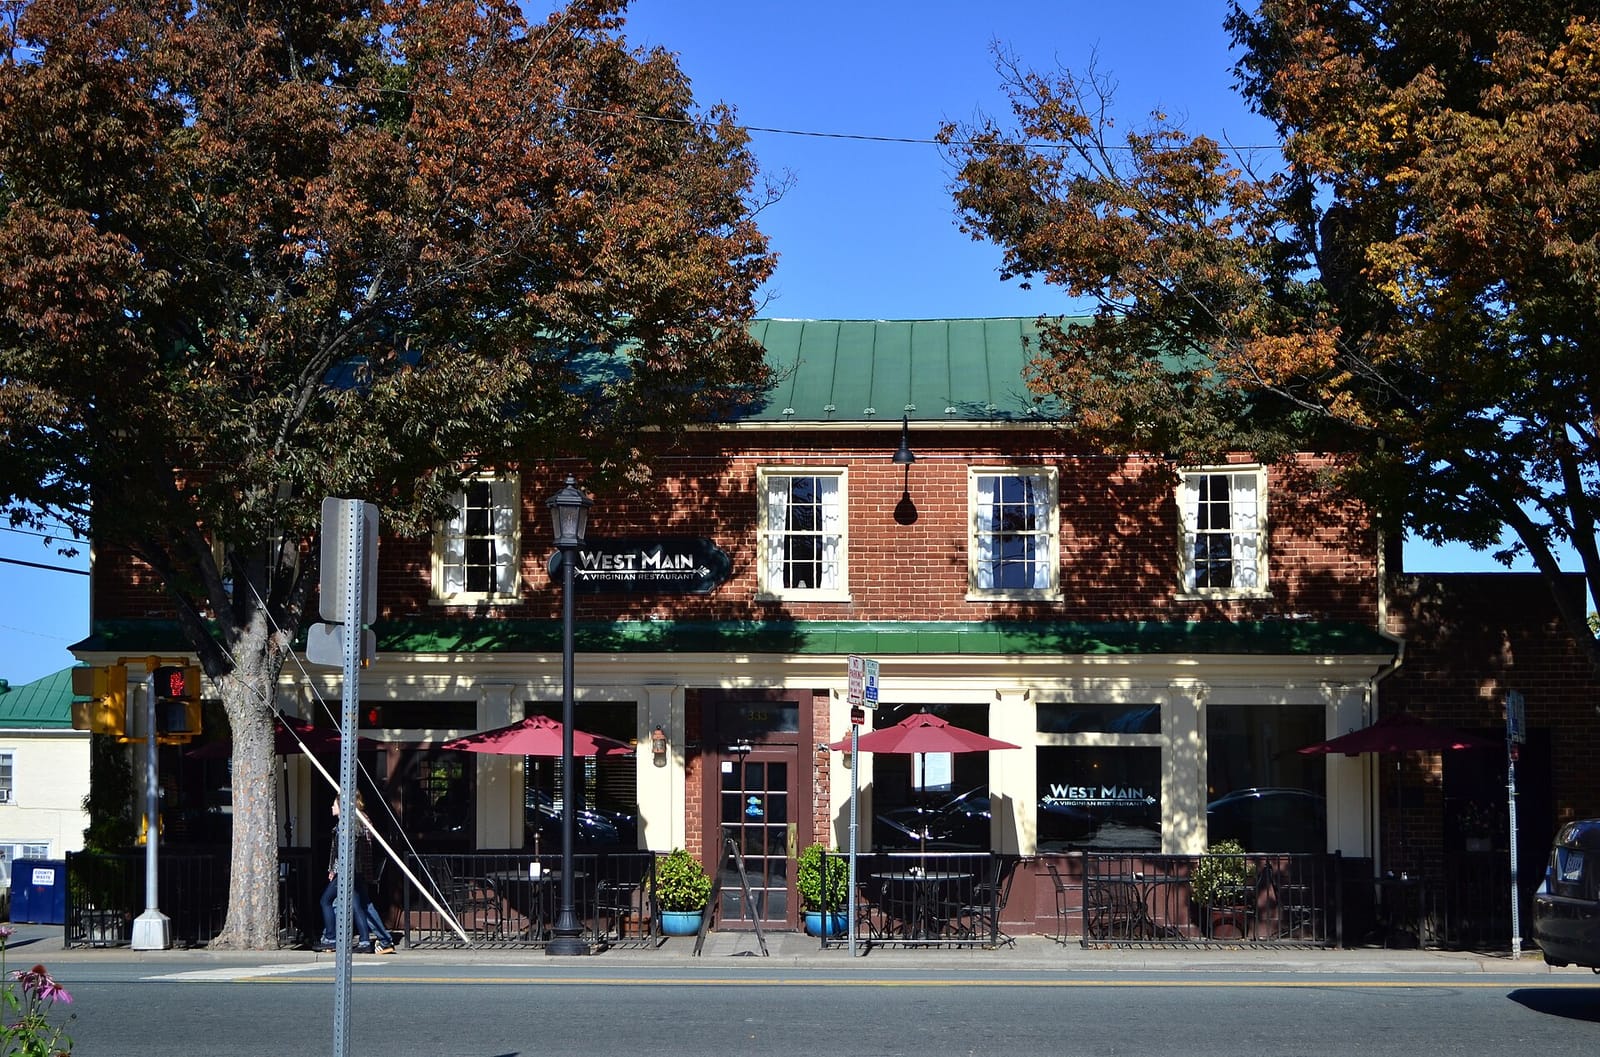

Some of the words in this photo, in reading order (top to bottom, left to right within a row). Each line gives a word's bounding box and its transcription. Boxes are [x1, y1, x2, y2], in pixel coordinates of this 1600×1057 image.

[579, 550, 636, 570] WEST
[641, 550, 694, 569] MAIN
[1050, 783, 1097, 798] WEST
[1101, 784, 1143, 799] MAIN
